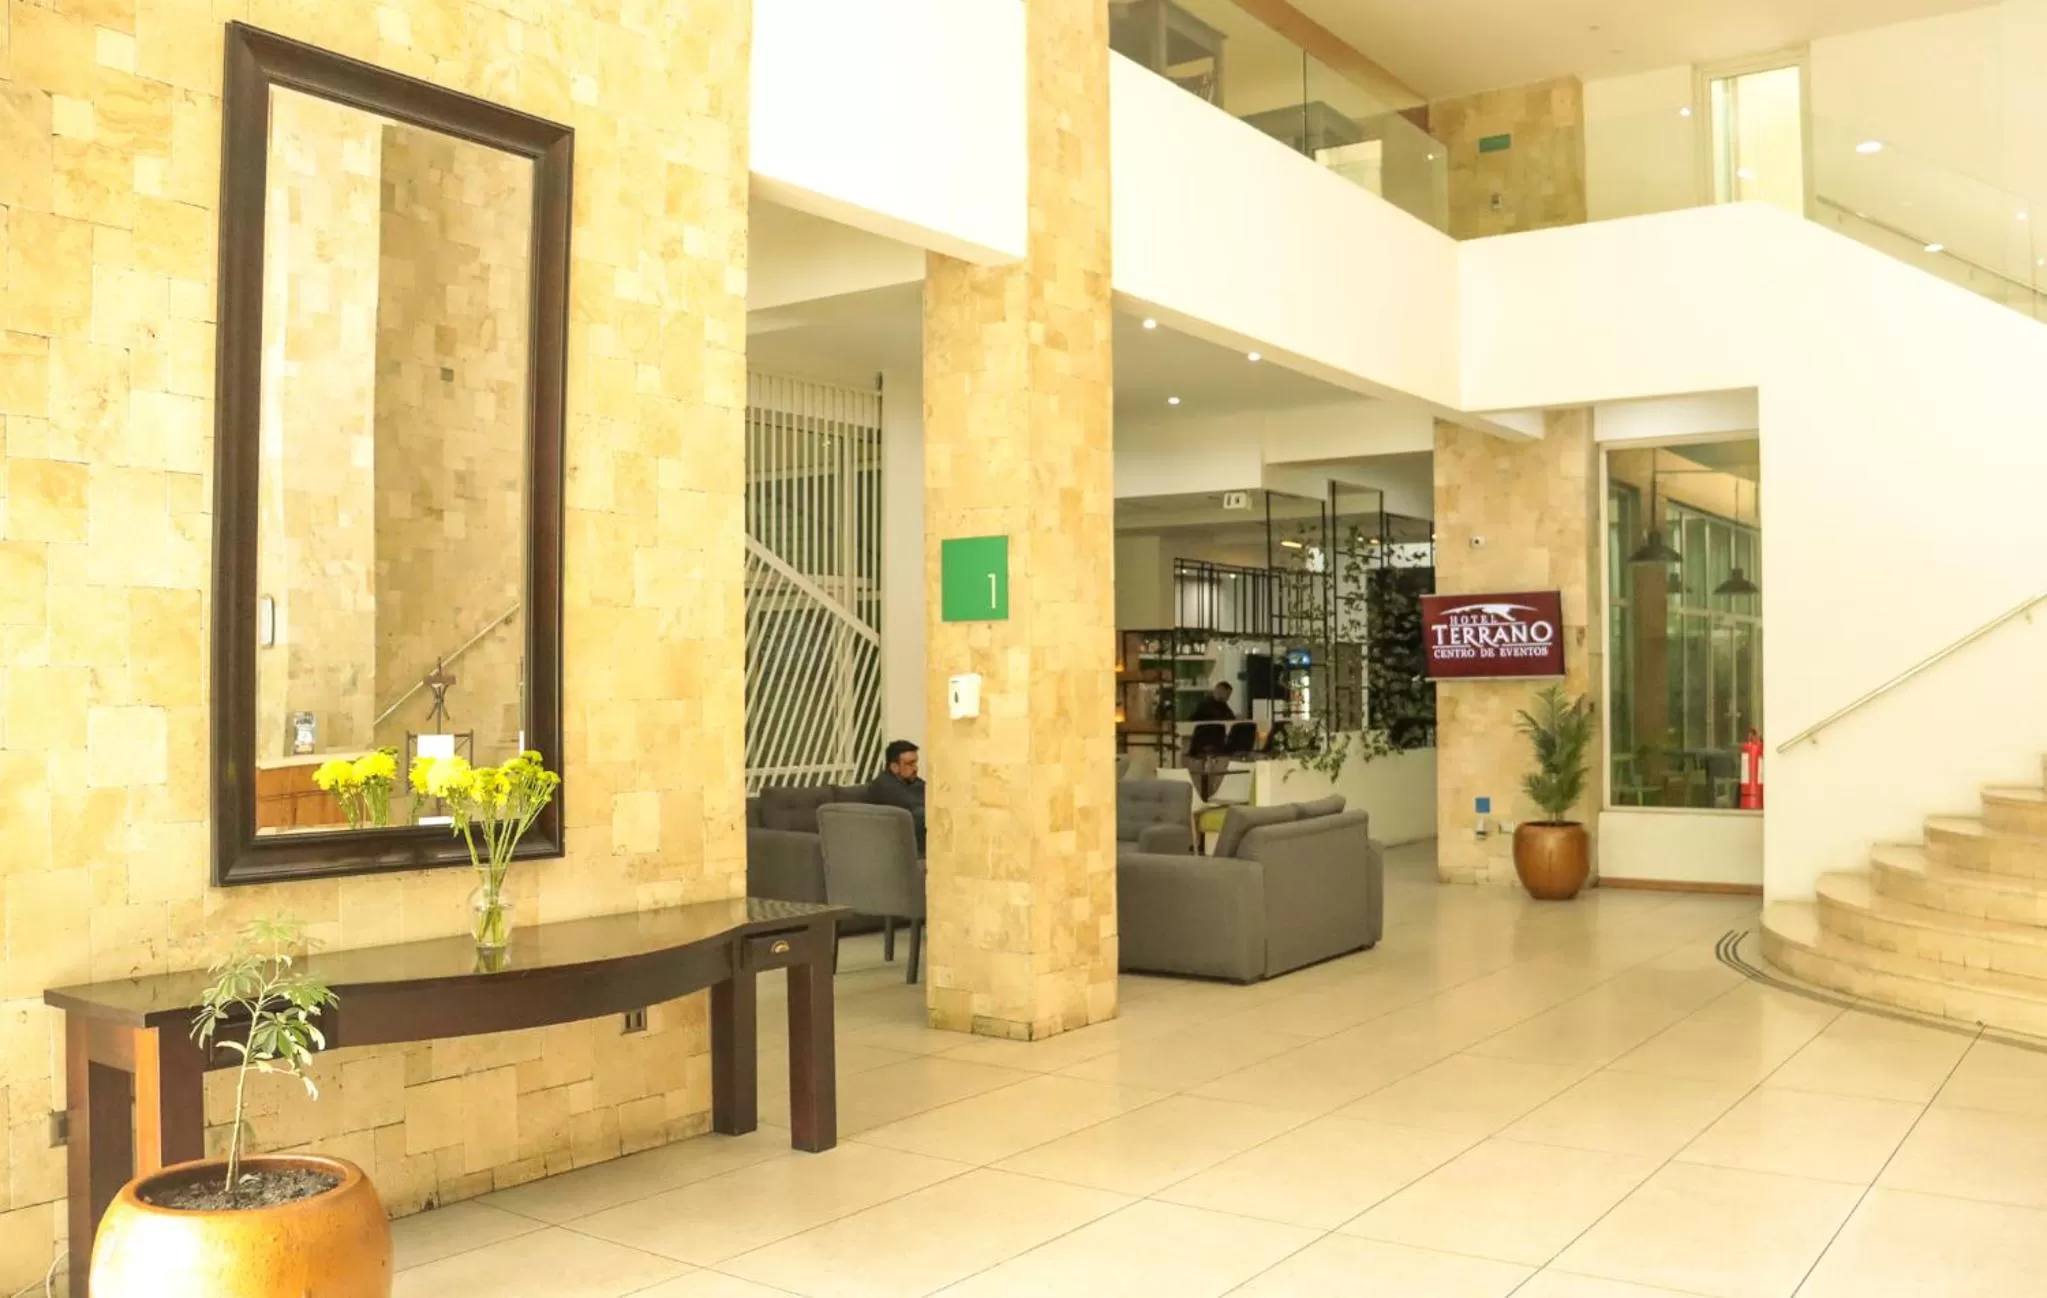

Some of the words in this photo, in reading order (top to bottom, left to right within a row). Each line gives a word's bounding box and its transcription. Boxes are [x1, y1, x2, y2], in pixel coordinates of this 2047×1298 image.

[987, 572, 997, 610] 1
[1450, 614, 1498, 626] HOTEL
[1431, 620, 1553, 648] TERRANO
[1434, 648, 1475, 659] CENTRO
[1480, 648, 1496, 658] DE
[1500, 646, 1549, 657] EVENTOS
